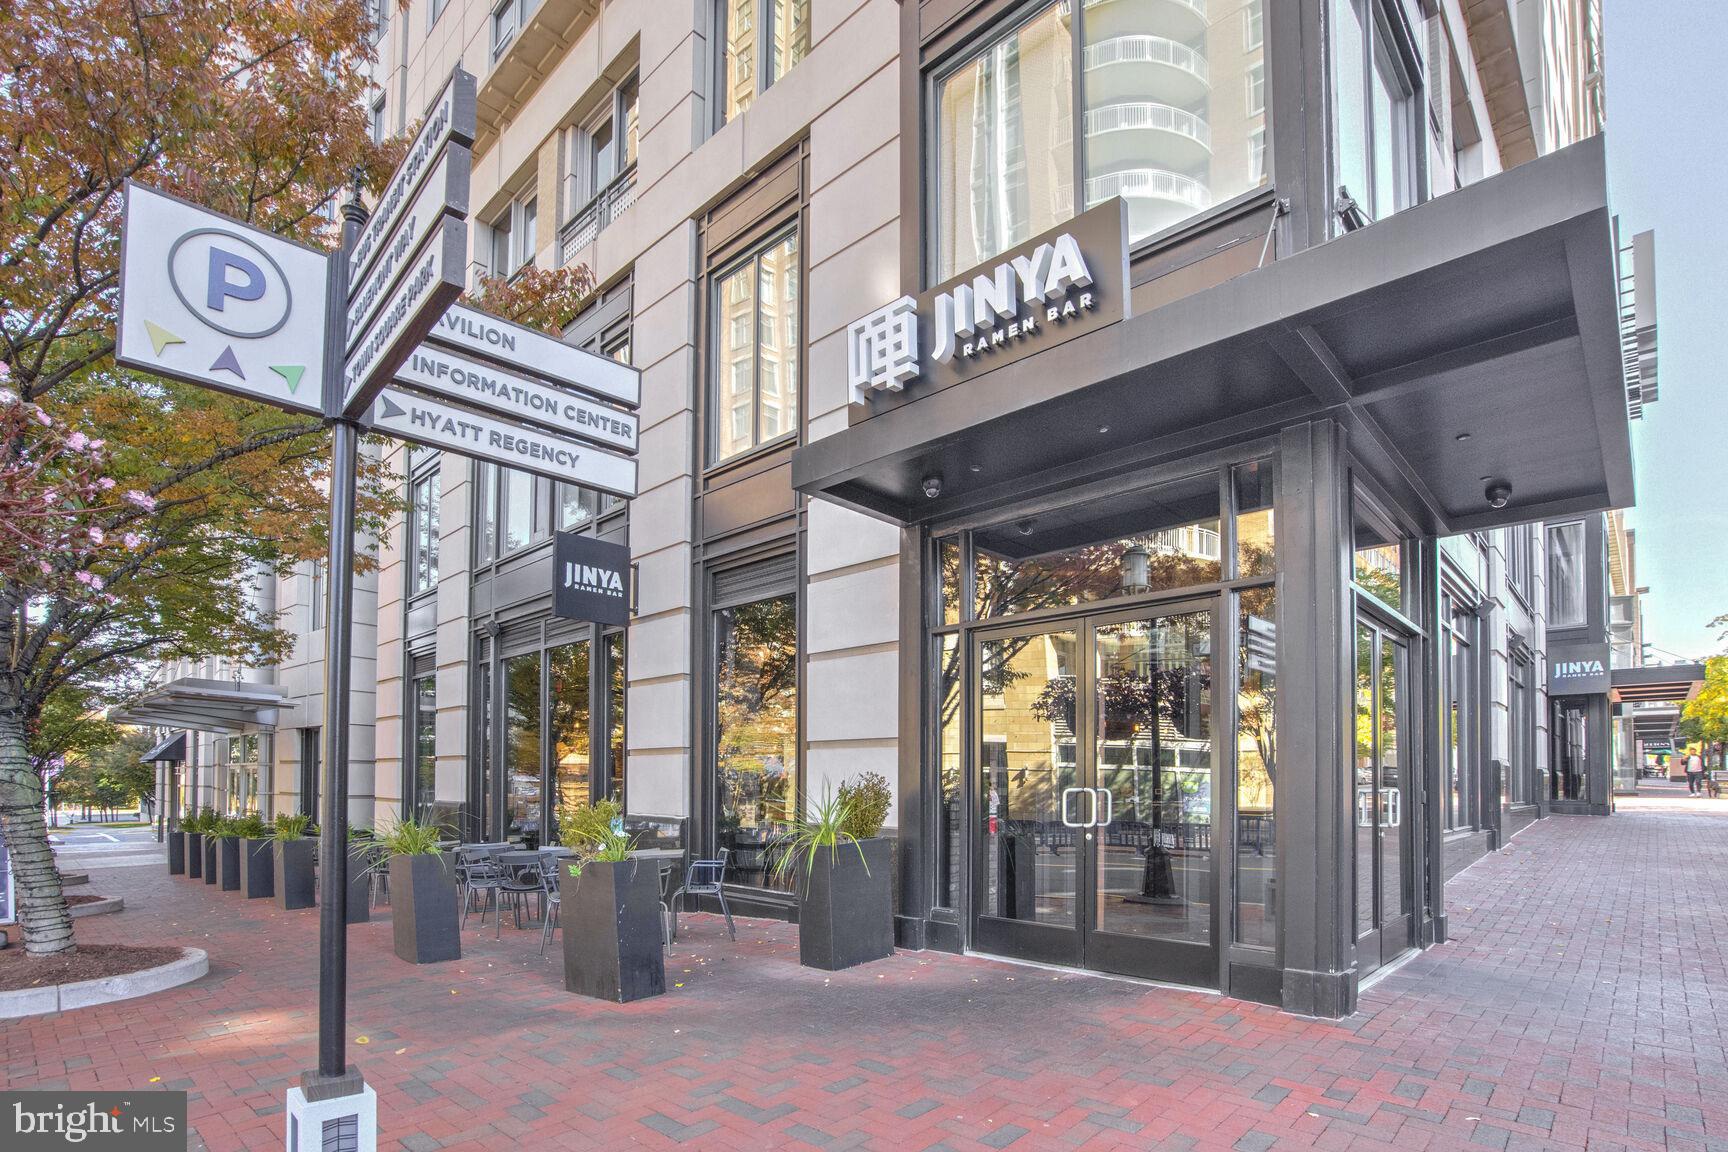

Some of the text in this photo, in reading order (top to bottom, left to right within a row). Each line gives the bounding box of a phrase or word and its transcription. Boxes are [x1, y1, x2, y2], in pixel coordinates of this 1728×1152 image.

[357, 100, 449, 268] BUS TRANSIT STATION
[207, 246, 267, 312] P
[354, 215, 417, 326] BLUEMONT WAY
[931, 232, 1094, 365] JINYA
[352, 254, 435, 383] TOWN SQUARE PARK
[437, 311, 517, 352] VILION
[962, 292, 1094, 358] RAMEN BAR
[412, 354, 633, 440] INFORMATION CENTER
[410, 407, 580, 468] HYATT REGENCY
[564, 561, 624, 591] JINYA
[1554, 660, 1604, 679] JINYA
